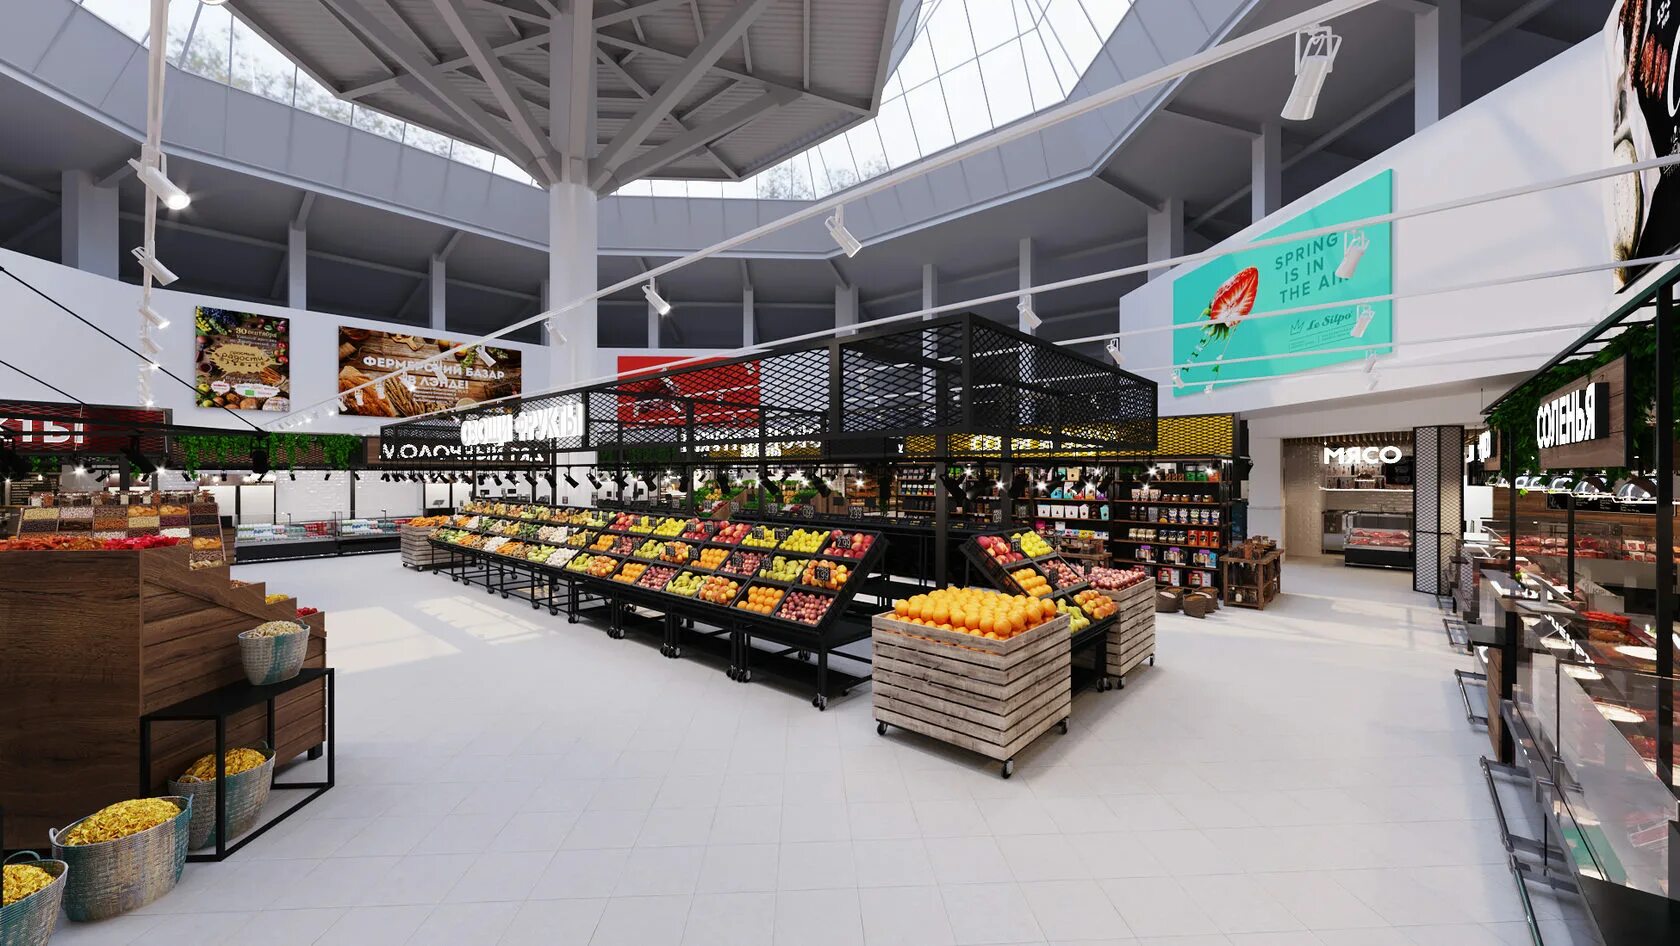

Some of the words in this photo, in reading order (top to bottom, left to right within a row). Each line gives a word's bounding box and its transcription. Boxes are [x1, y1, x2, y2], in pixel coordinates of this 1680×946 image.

[1275, 232, 1338, 270] SPRING
[1285, 267, 1299, 284] IS
[1307, 257, 1324, 275] IN
[1279, 281, 1311, 304] THE
[465, 367, 505, 380] БАЗАР
[461, 413, 513, 446] ОВОЩИ
[514, 402, 585, 441] ФРУКТЫ
[1536, 382, 1597, 449] СОЛЕНЬЯ
[1323, 445, 1402, 465] МЯСО
